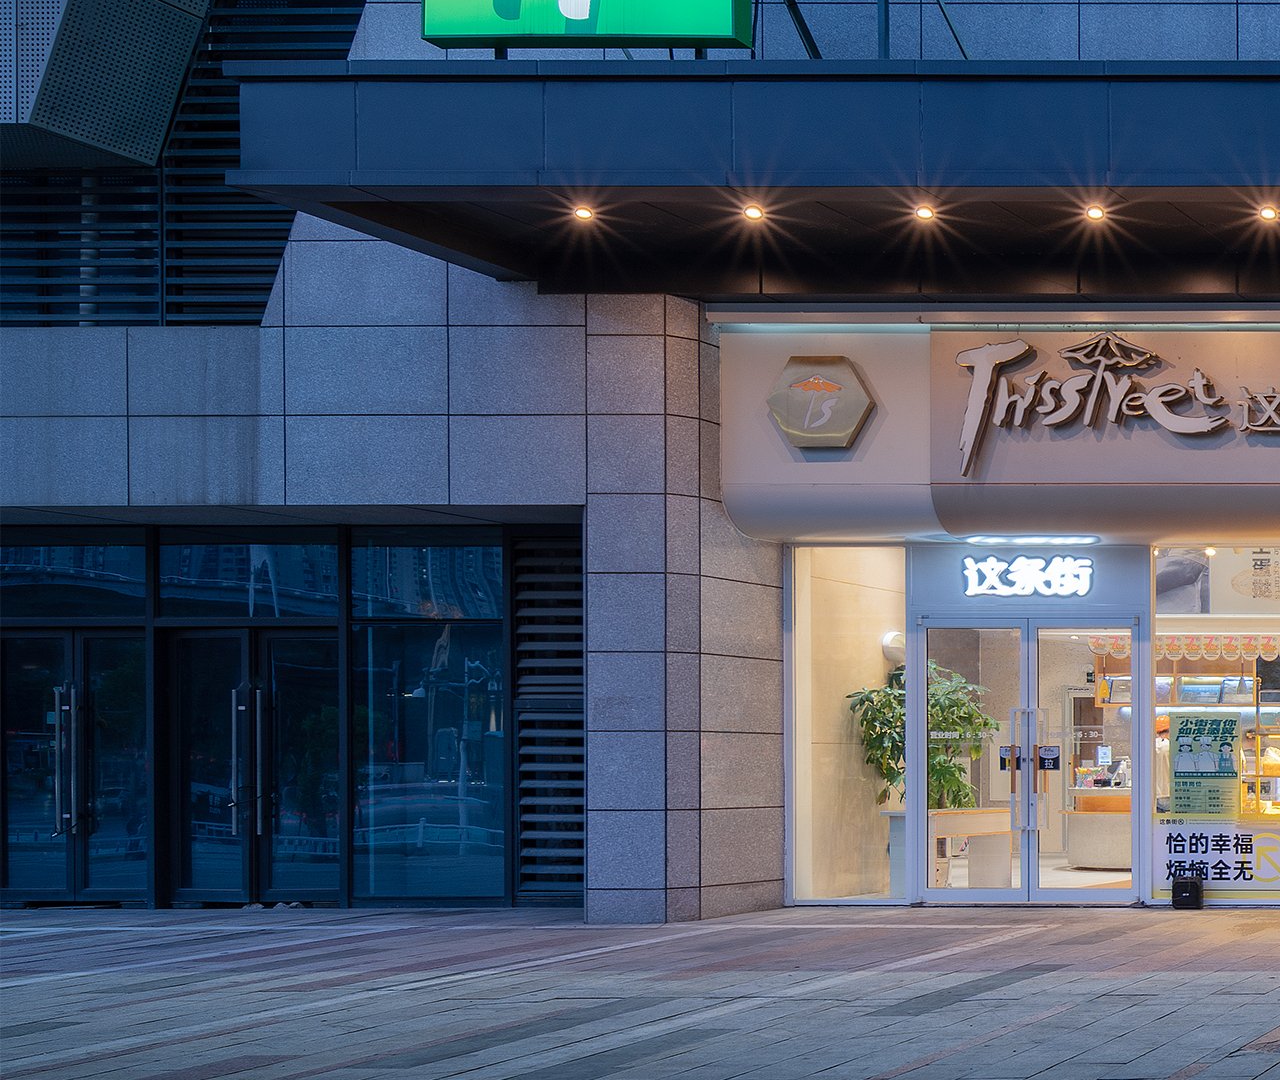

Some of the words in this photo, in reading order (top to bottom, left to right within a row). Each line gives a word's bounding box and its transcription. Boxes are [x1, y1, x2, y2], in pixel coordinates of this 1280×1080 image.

[962, 556, 1094, 597] 这条街
[1044, 759, 1054, 769] 拉
[1165, 832, 1254, 855] 恰的幸福
